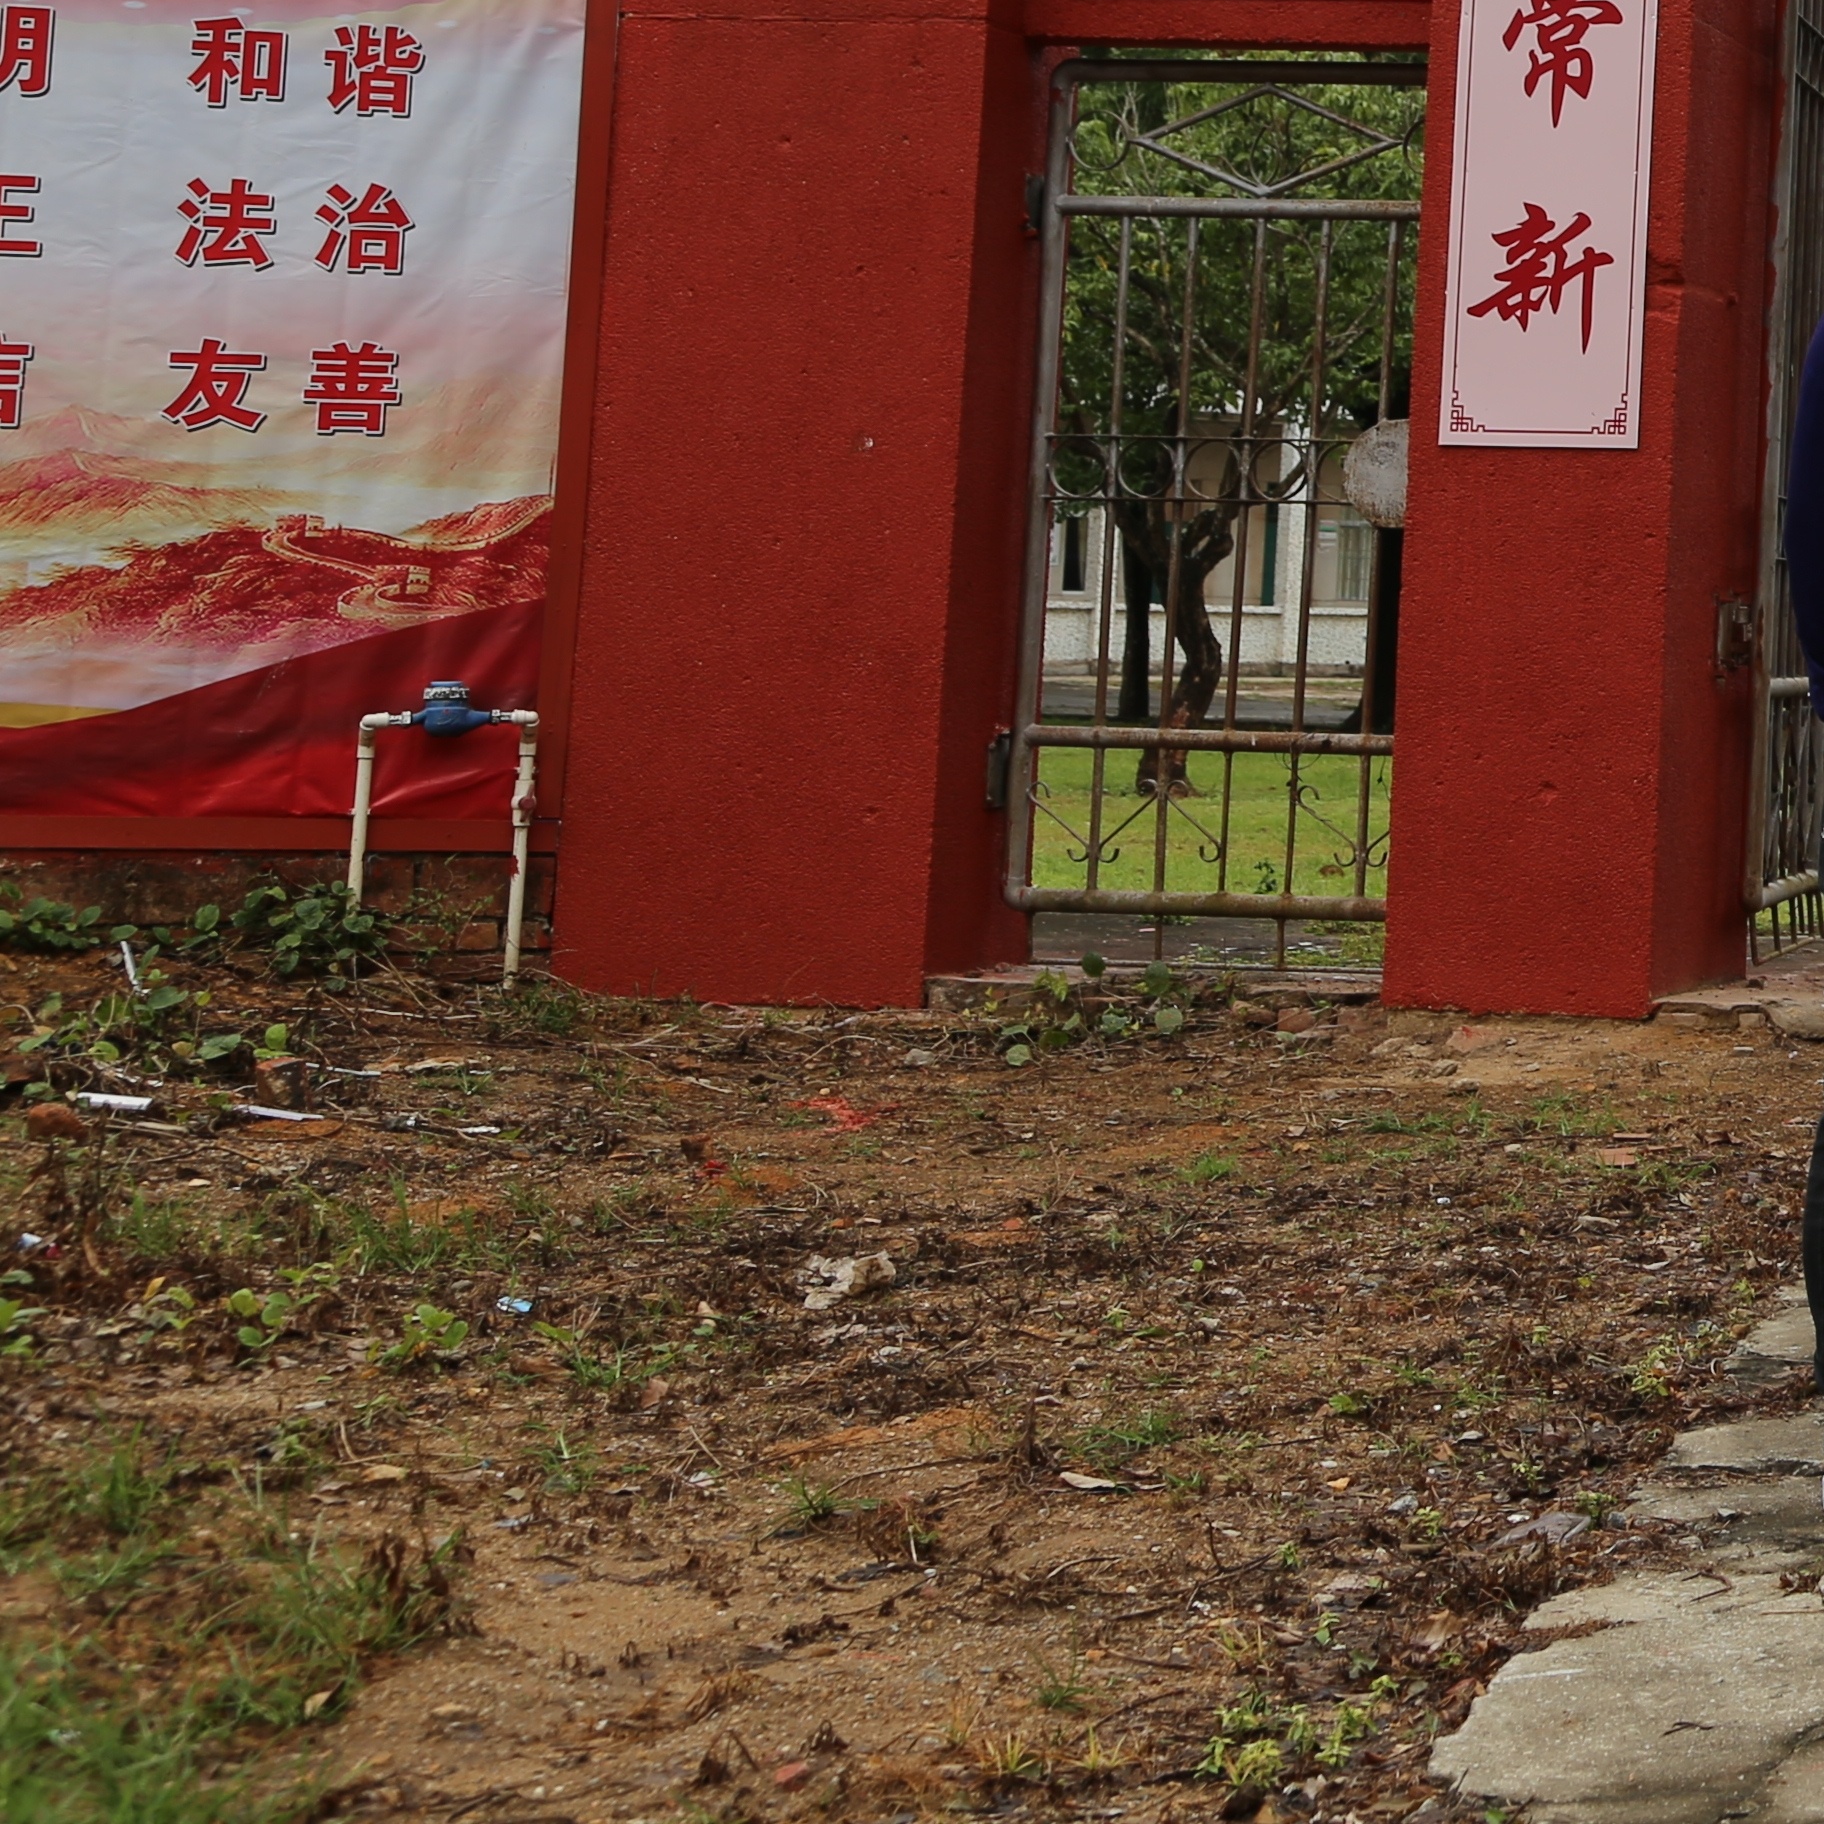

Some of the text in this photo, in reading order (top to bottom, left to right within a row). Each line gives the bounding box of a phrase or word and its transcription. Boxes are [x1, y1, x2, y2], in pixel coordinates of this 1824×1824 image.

[187, 14, 425, 118] 和谐
[174, 176, 415, 276] 法治
[162, 338, 403, 437] 友善
